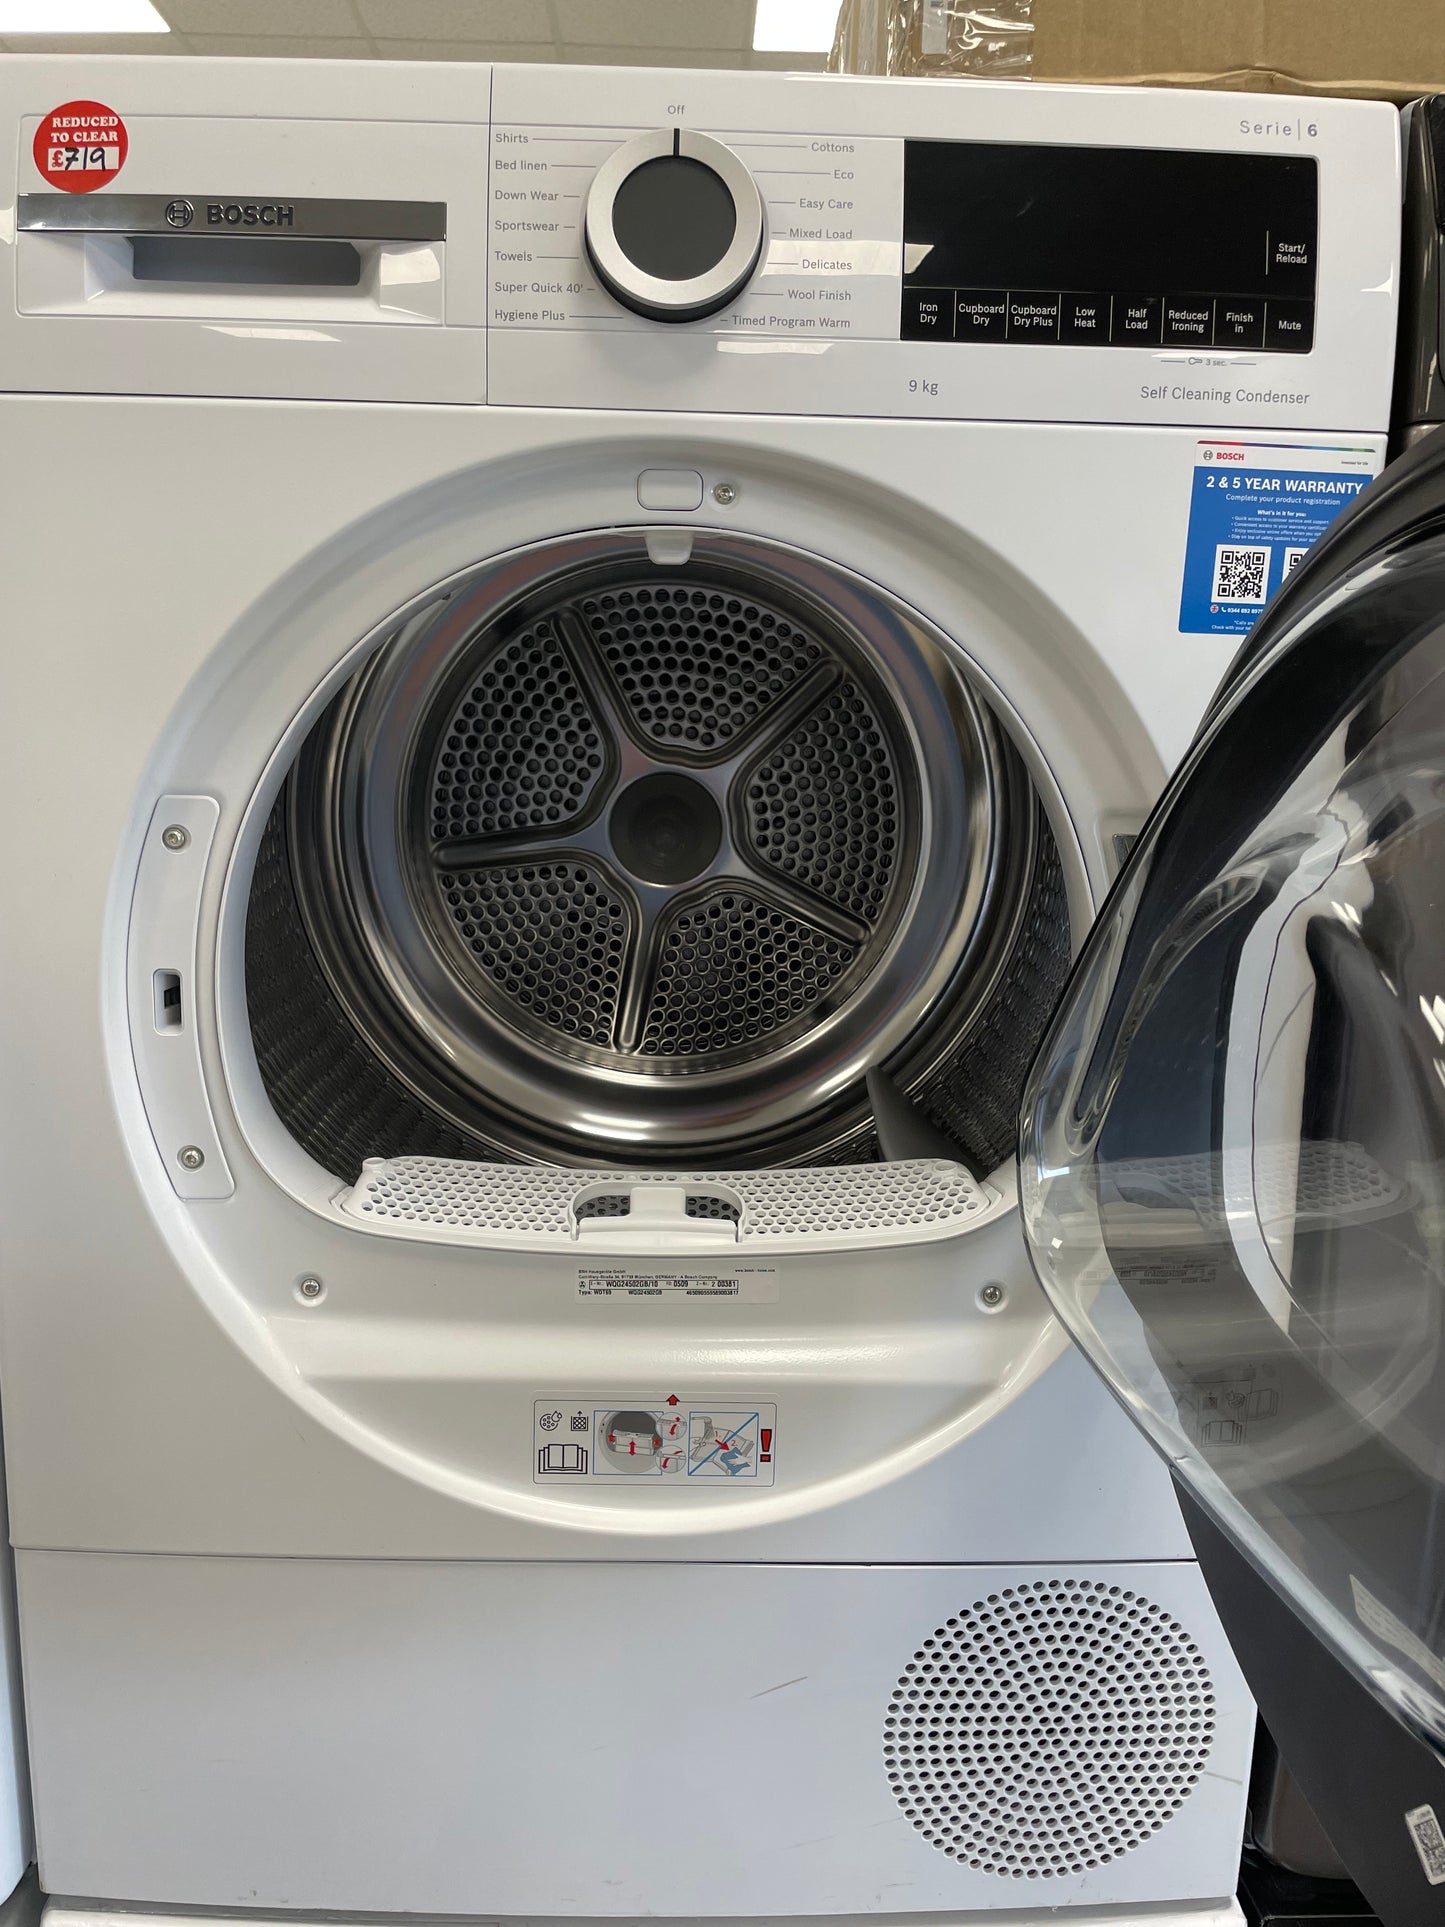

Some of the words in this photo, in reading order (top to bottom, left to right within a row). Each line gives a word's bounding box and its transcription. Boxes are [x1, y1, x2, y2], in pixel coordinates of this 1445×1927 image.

[667, 105, 685, 115] Off
[53, 117, 118, 127] REDUCED
[1239, 120, 1292, 136] Serie
[1307, 123, 1318, 137] 6
[51, 133, 69, 142] TO
[73, 131, 118, 142] CLEAR
[495, 134, 529, 144] Shirts
[811, 142, 854, 153] Cottons
[495, 160, 516, 170] Bed
[520, 160, 547, 171] linen
[834, 170, 854, 179] Eco
[495, 190, 527, 200] Down
[530, 191, 559, 201] Wear
[800, 199, 824, 211] Easy
[827, 200, 853, 209] Care
[207, 203, 294, 226] BOSCH
[495, 221, 559, 233] Sportswear
[789, 228, 819, 239] Mixed
[822, 229, 853, 239] Load
[1278, 243, 1306, 254] Start/
[495, 251, 532, 261] Towels
[1276, 255, 1307, 264] Reload
[802, 259, 852, 270] Delicates
[495, 283, 528, 294] Super
[531, 283, 563, 294] Quick
[788, 290, 815, 300] Wool
[819, 290, 851, 300] Finish
[920, 302, 938, 311] Iron
[959, 304, 1004, 314] Cupboard
[1011, 305, 1057, 316] Cupboard
[1076, 307, 1095, 316] Low
[495, 310, 538, 323] Hygiene
[542, 311, 565, 321] Plus
[920, 314, 937, 324] Dry
[1128, 309, 1147, 318] Half
[1169, 310, 1208, 320] Reduced
[1226, 313, 1253, 322] Finish
[732, 316, 766, 326] Timed
[769, 316, 816, 329] Program
[819, 317, 850, 328] Warm
[973, 315, 990, 326] Dry
[1014, 317, 1030, 327] Dry
[1033, 317, 1053, 326] Plus
[1074, 318, 1096, 327] Heat
[1126, 320, 1148, 329] Load
[1279, 321, 1301, 330] Mute
[1172, 322, 1204, 334] Ironing
[1235, 324, 1243, 333] in
[909, 380, 917, 393] 9
[922, 379, 939, 396] kg
[1141, 386, 1167, 399] Self
[1172, 387, 1231, 403] Cleaning
[1236, 389, 1310, 404] Condenser
[1216, 452, 1244, 460] BOSCH
[1207, 476, 1214, 488] 2
[1219, 477, 1228, 488] &
[1233, 477, 1240, 489] 5
[1245, 478, 1280, 490] YEAR
[1285, 479, 1363, 494] WARRANTY
[1226, 494, 1257, 502] Complete
[1276, 496, 1301, 505] product
[1303, 498, 1340, 506] registration
